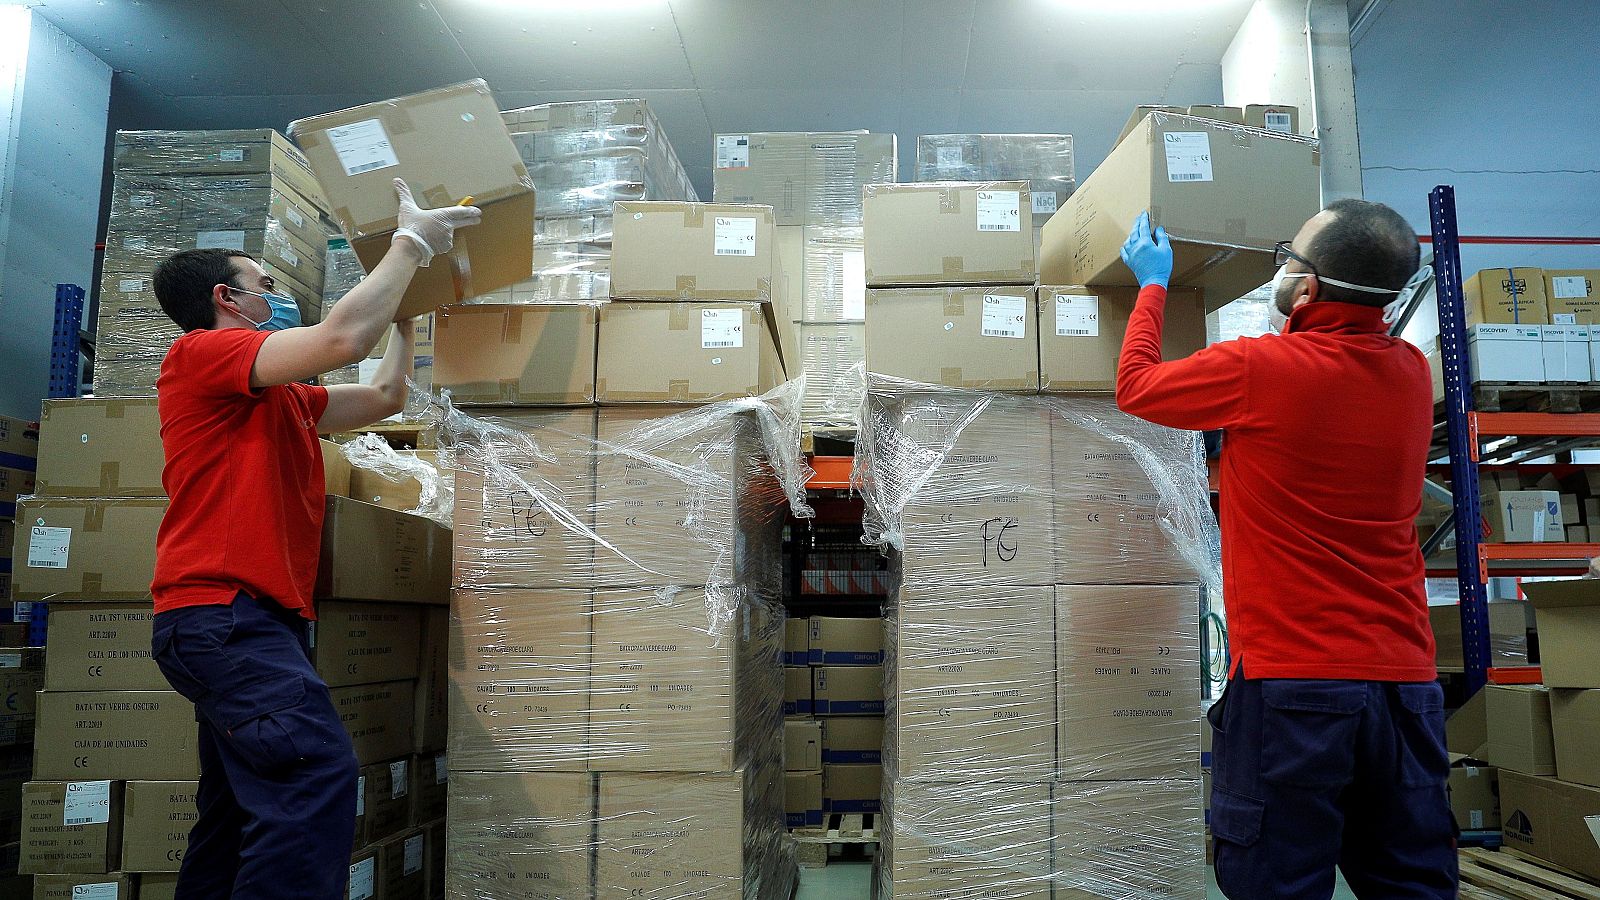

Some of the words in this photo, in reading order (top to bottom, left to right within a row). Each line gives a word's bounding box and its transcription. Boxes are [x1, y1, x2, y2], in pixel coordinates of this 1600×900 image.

[1037, 197, 1055, 206] NaCl
[626, 517, 636, 526] CE
[1088, 513, 1099, 522] CE
[90, 614, 106, 622] BATA
[88, 650, 104, 658] CAJA
[108, 650, 116, 658] DE
[1158, 646, 1170, 655] CE
[88, 666, 102, 676] CE
[133, 702, 159, 710] OSCURO
[476, 704, 488, 713] CE
[116, 740, 148, 748] UNIDADES
[74, 757, 88, 768] CE
[167, 850, 182, 861] CE
